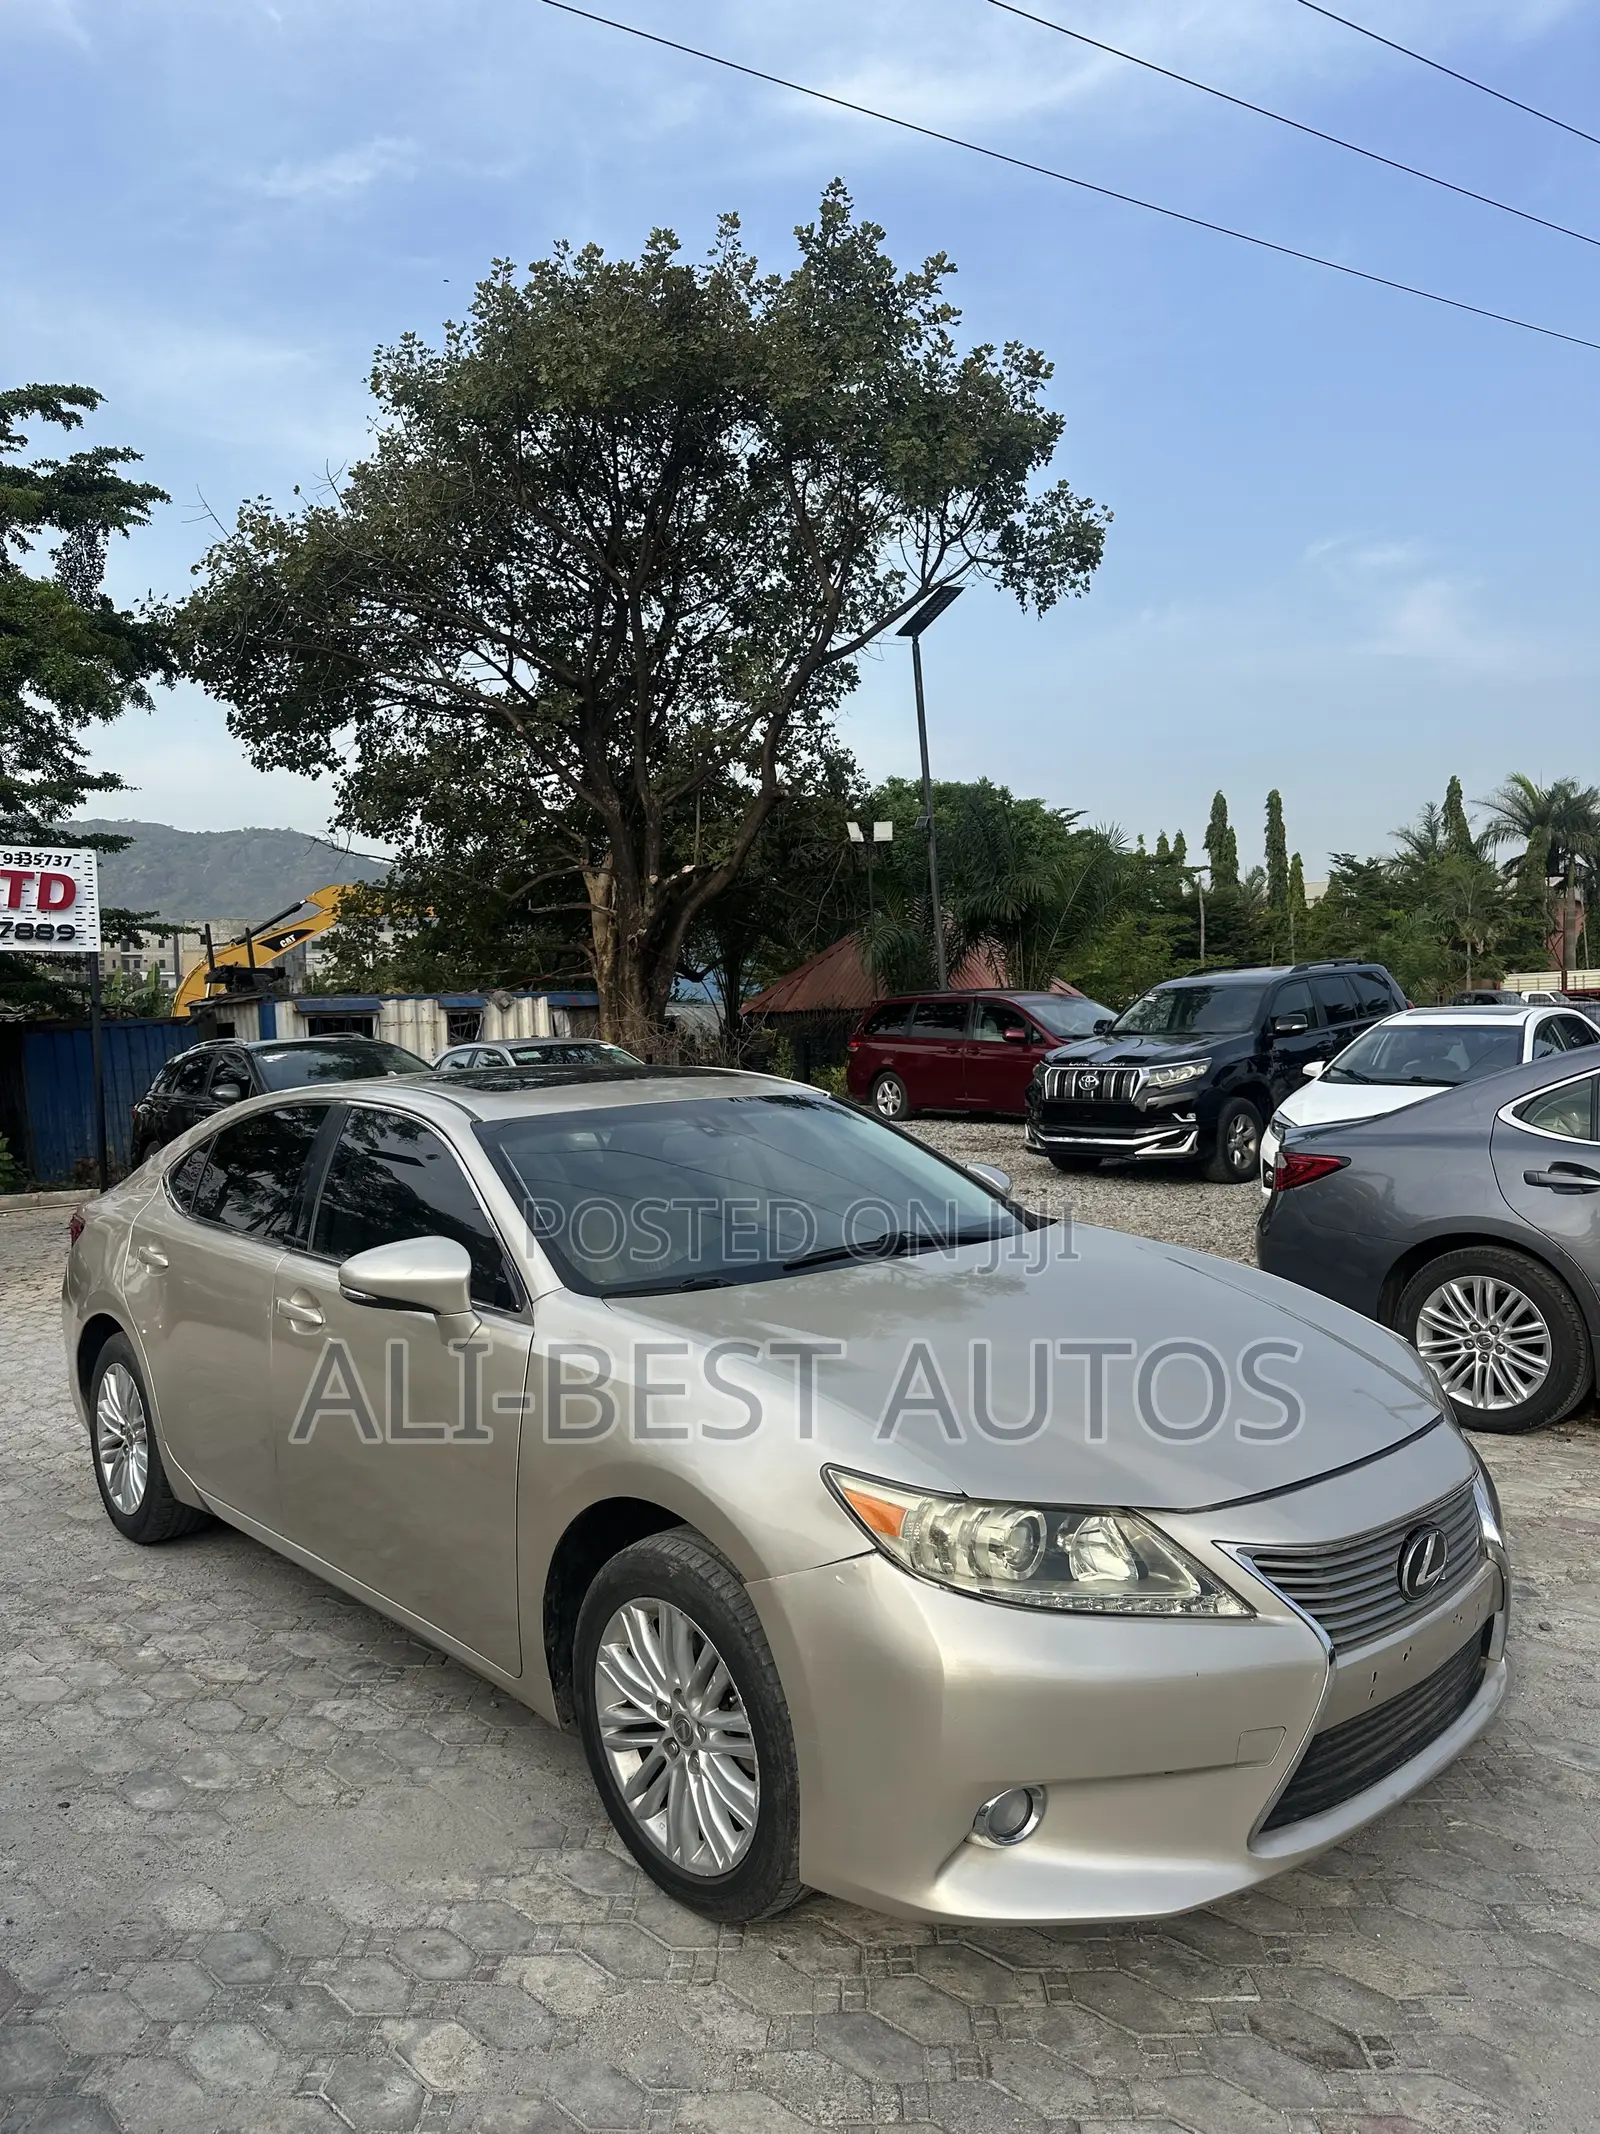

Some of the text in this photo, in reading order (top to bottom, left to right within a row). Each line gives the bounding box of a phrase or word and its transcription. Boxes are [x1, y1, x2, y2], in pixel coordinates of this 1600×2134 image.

[3, 852, 72, 867] 9335737
[0, 869, 76, 912] TD
[0, 921, 76, 941] 7889
[280, 934, 296, 948] CAT
